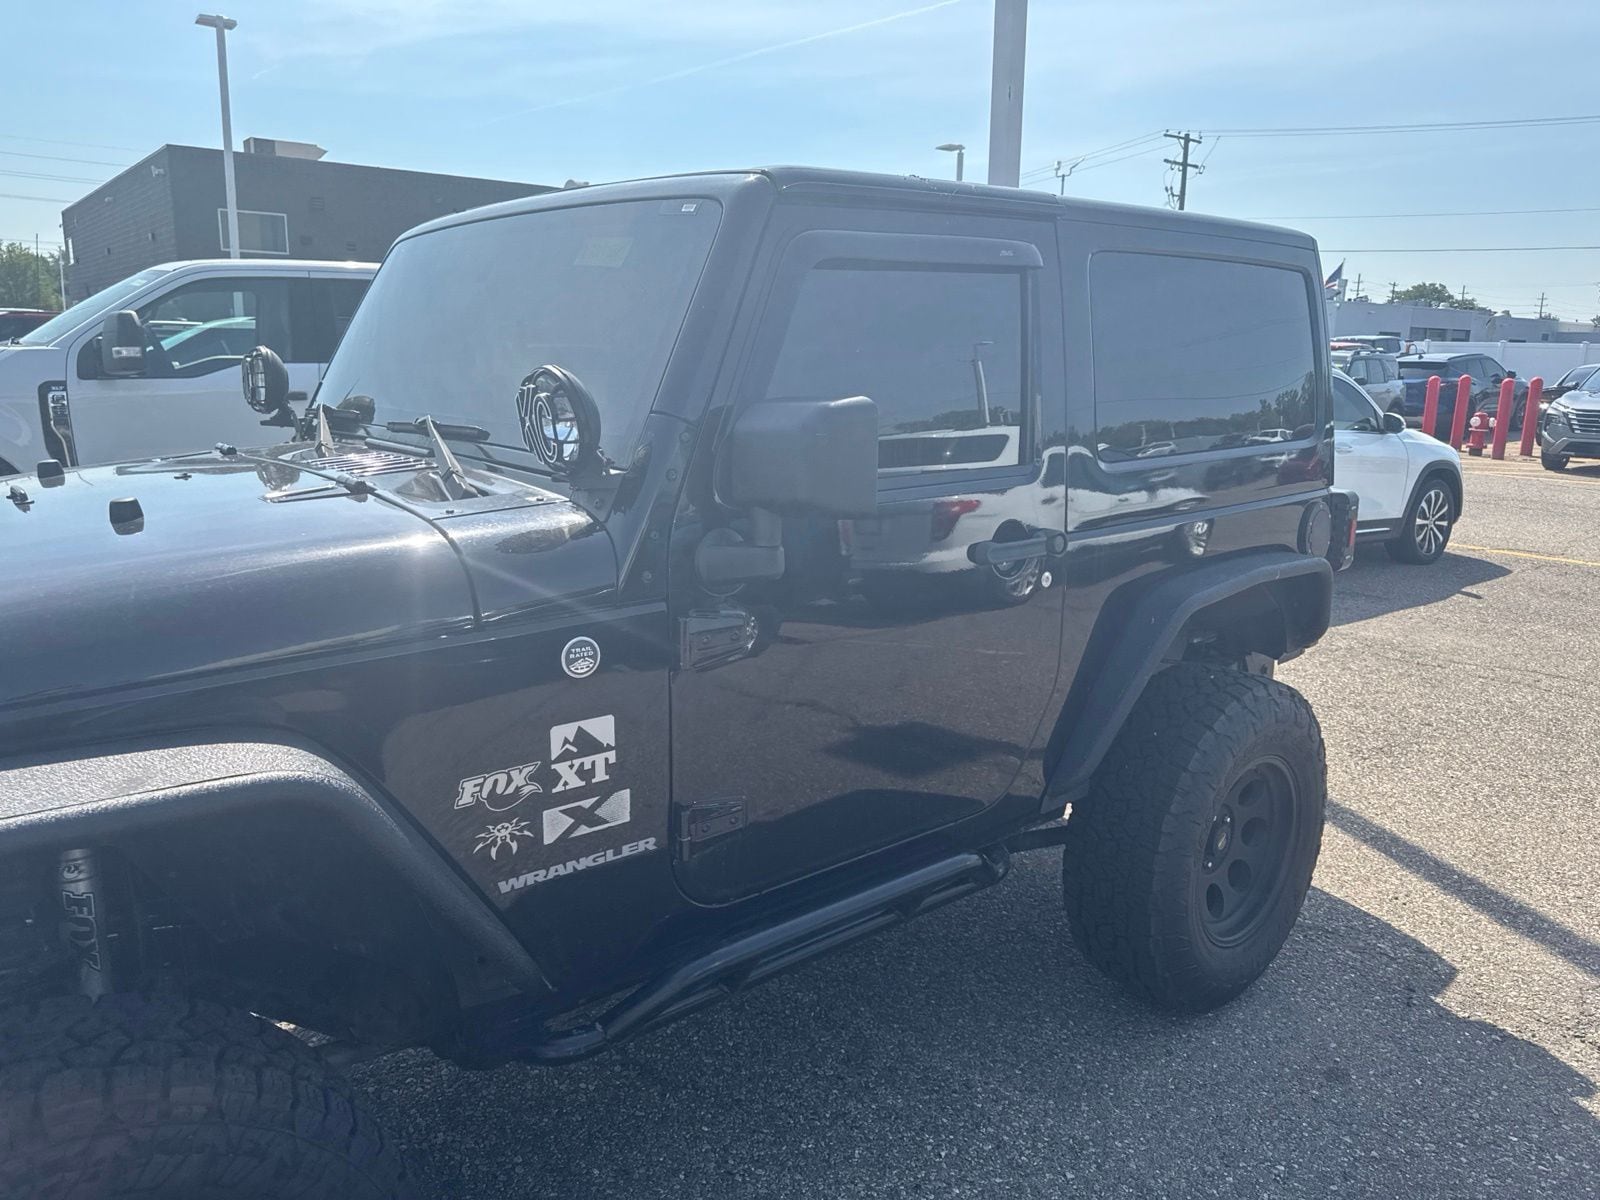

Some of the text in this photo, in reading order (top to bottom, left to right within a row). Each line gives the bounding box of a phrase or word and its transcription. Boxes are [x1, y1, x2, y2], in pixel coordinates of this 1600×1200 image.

[569, 650, 594, 659] RATED
[454, 761, 543, 811] FOX
[550, 750, 616, 794] XT
[497, 837, 657, 894] WRANGLER
